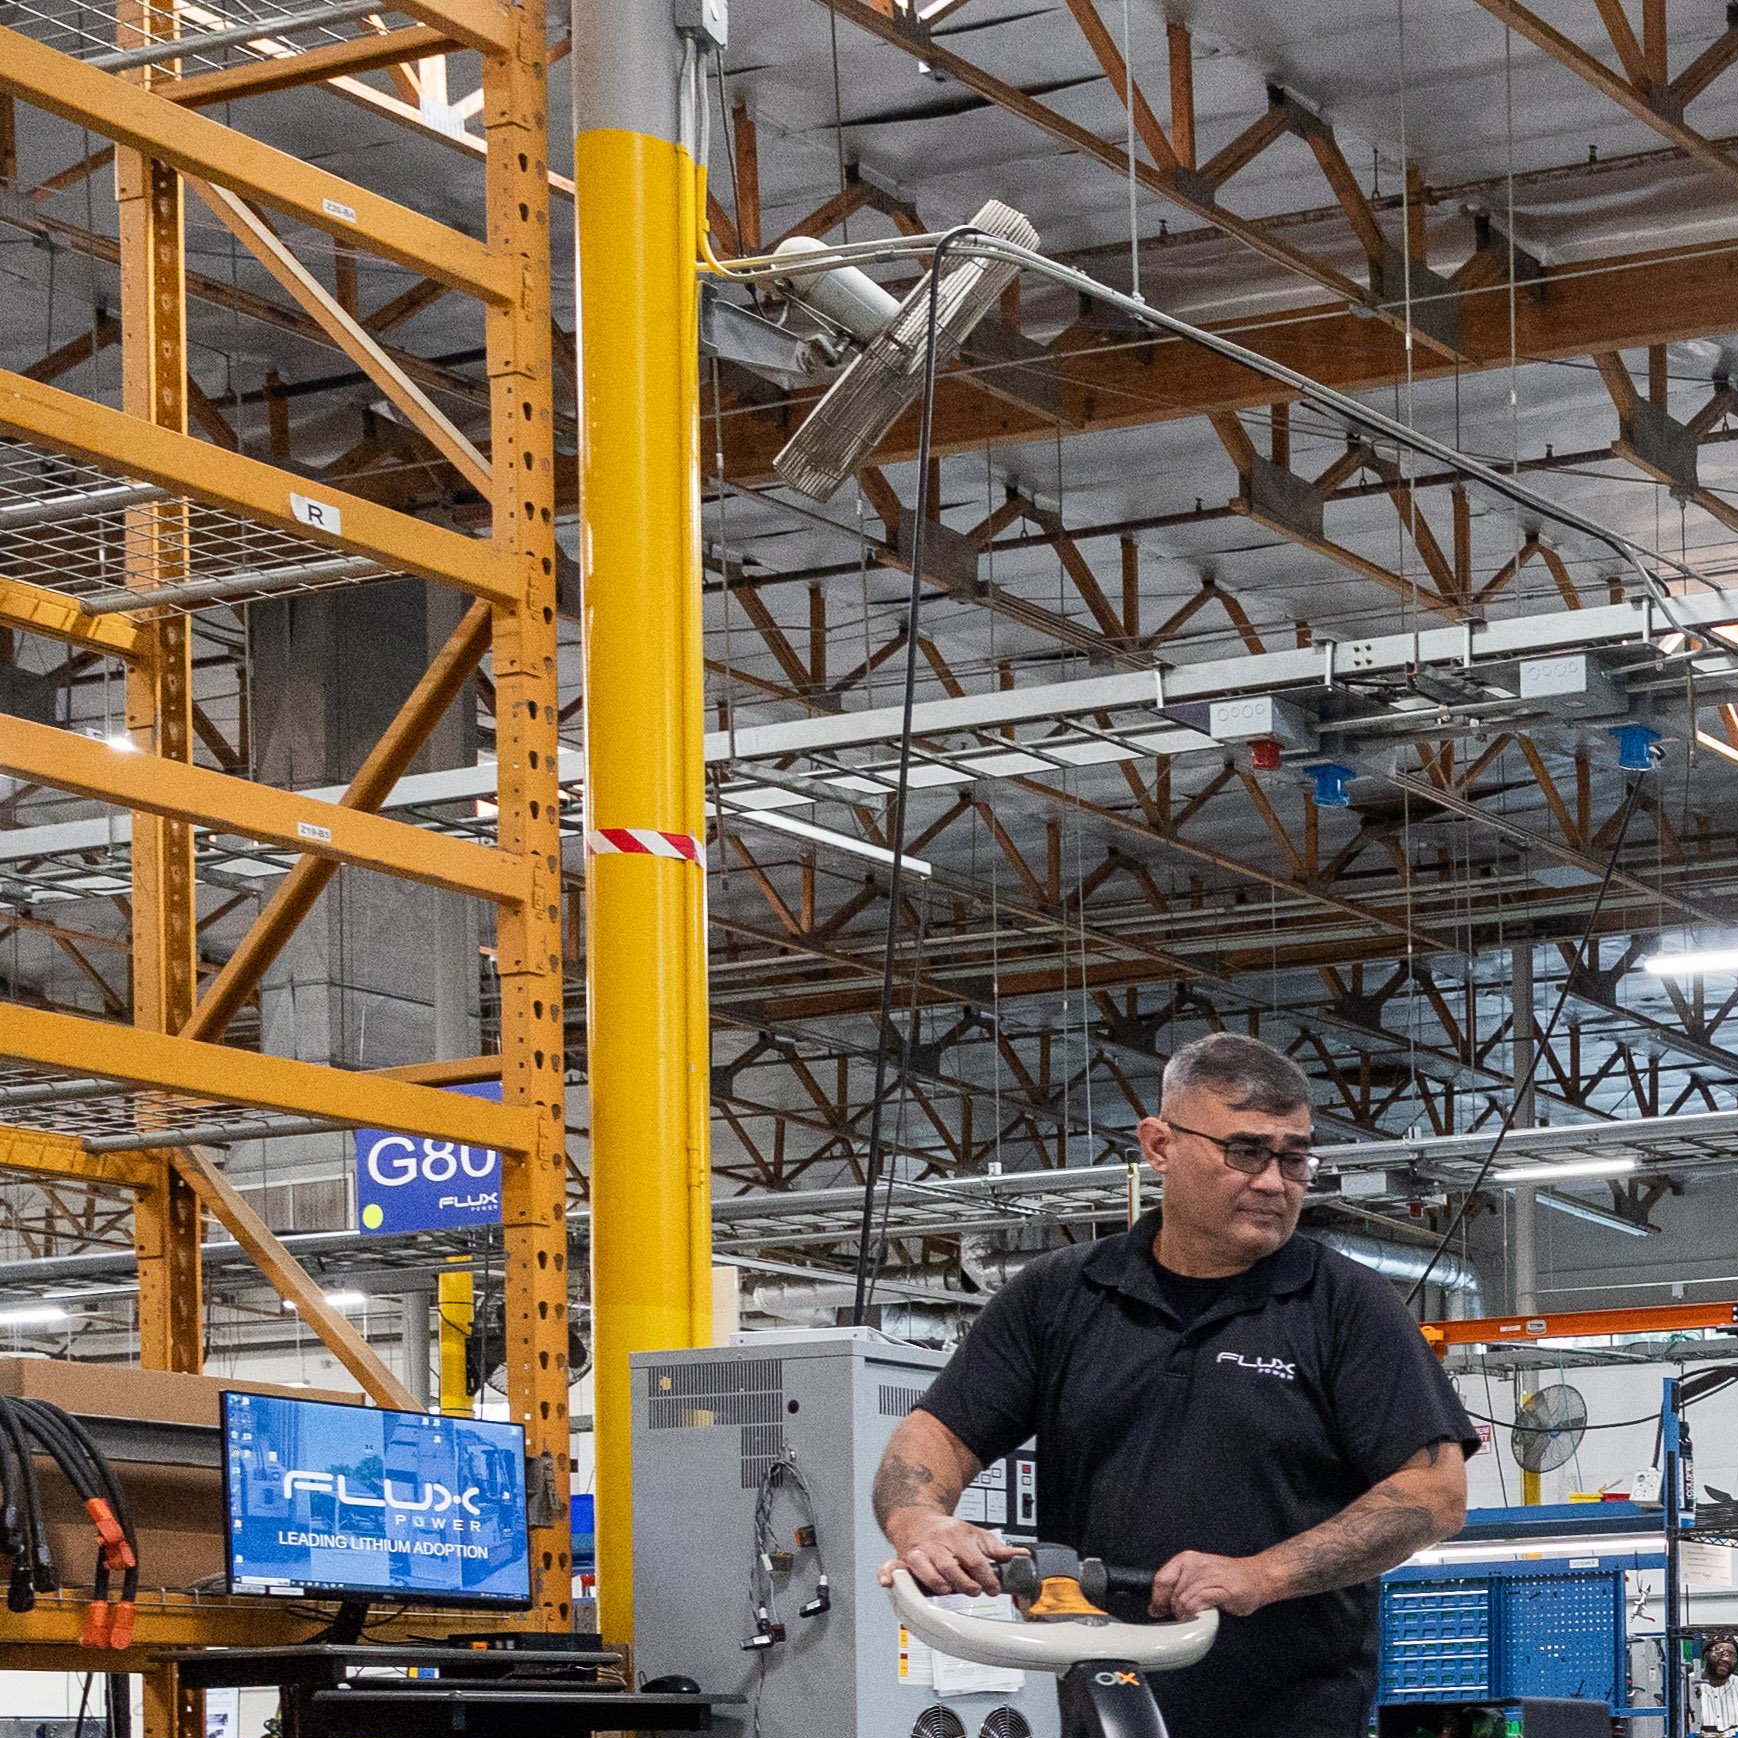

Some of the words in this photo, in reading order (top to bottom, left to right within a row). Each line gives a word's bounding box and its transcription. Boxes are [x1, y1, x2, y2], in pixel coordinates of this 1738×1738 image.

[307, 503, 325, 526] R
[368, 1136, 497, 1187] G80
[439, 1191, 499, 1209] FLUX
[1216, 1352, 1296, 1375] FLUX
[284, 1469, 481, 1516] FLUX
[395, 1514, 482, 1532] POWER
[278, 1530, 348, 1549] LEADING
[350, 1537, 411, 1554] LITHIUM
[412, 1541, 489, 1560] ADOPTION
